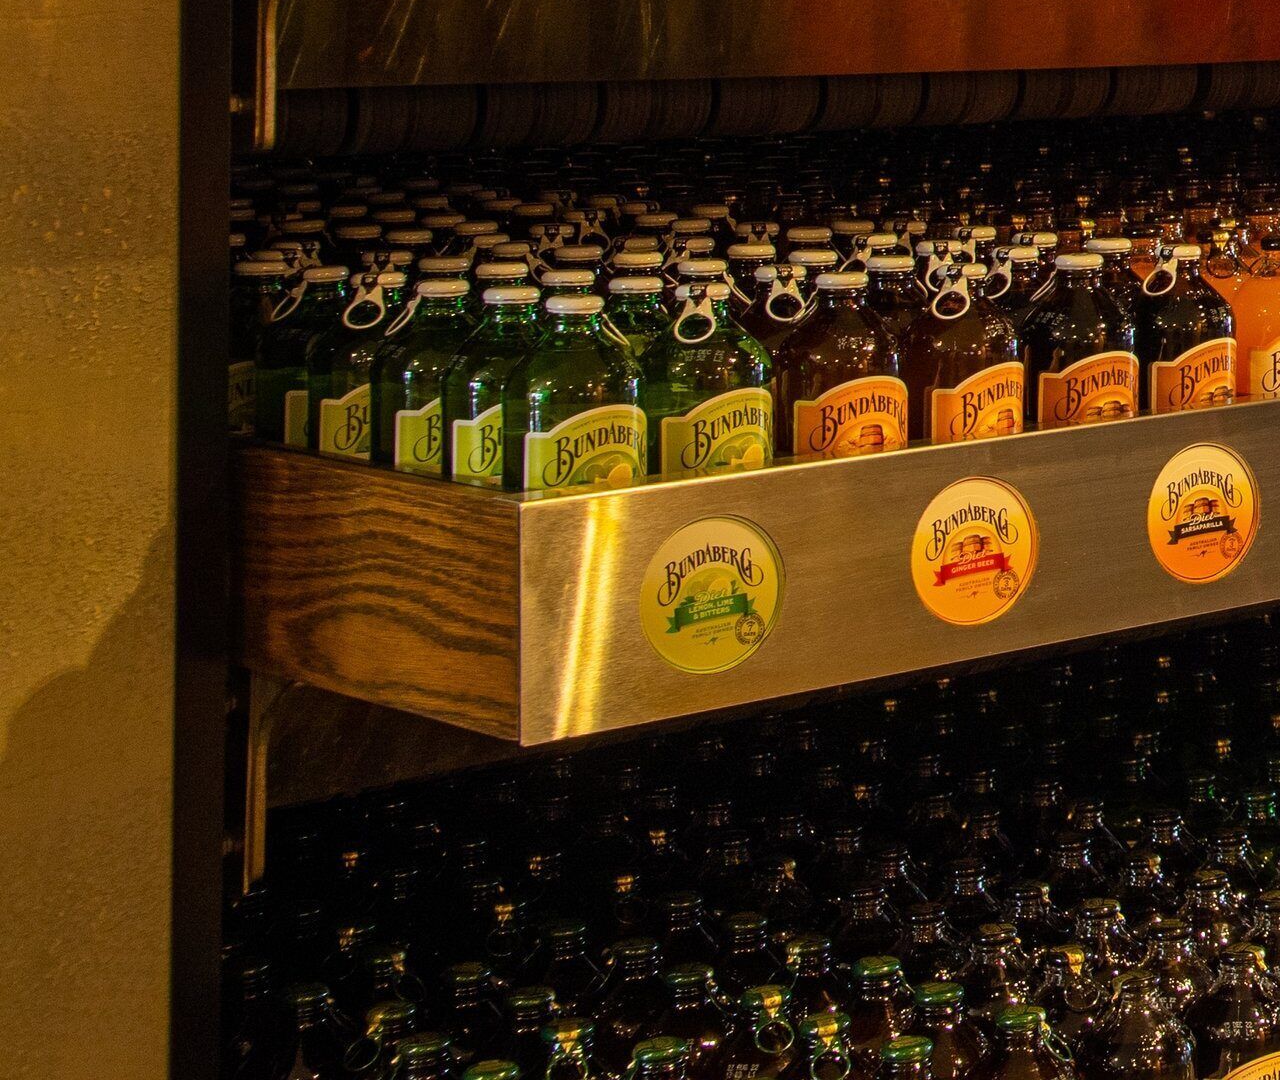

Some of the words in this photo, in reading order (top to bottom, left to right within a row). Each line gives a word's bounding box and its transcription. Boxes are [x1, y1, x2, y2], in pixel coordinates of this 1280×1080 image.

[1055, 364, 1138, 421] BUNDABER
[1169, 350, 1236, 405] BUNDAB
[950, 377, 1023, 436] BUNDABE
[680, 403, 772, 469] BUNDABER
[1161, 467, 1243, 521] BUNDABERG
[926, 502, 1019, 561] BUNDABERG
[1181, 520, 1223, 534] SARSAPARILLA
[658, 542, 764, 607] BUNDABERG
[951, 561, 976, 574] GINGER
[977, 559, 995, 568] BEER
[700, 606, 730, 618] BITTERS
[717, 598, 735, 608] LIME
